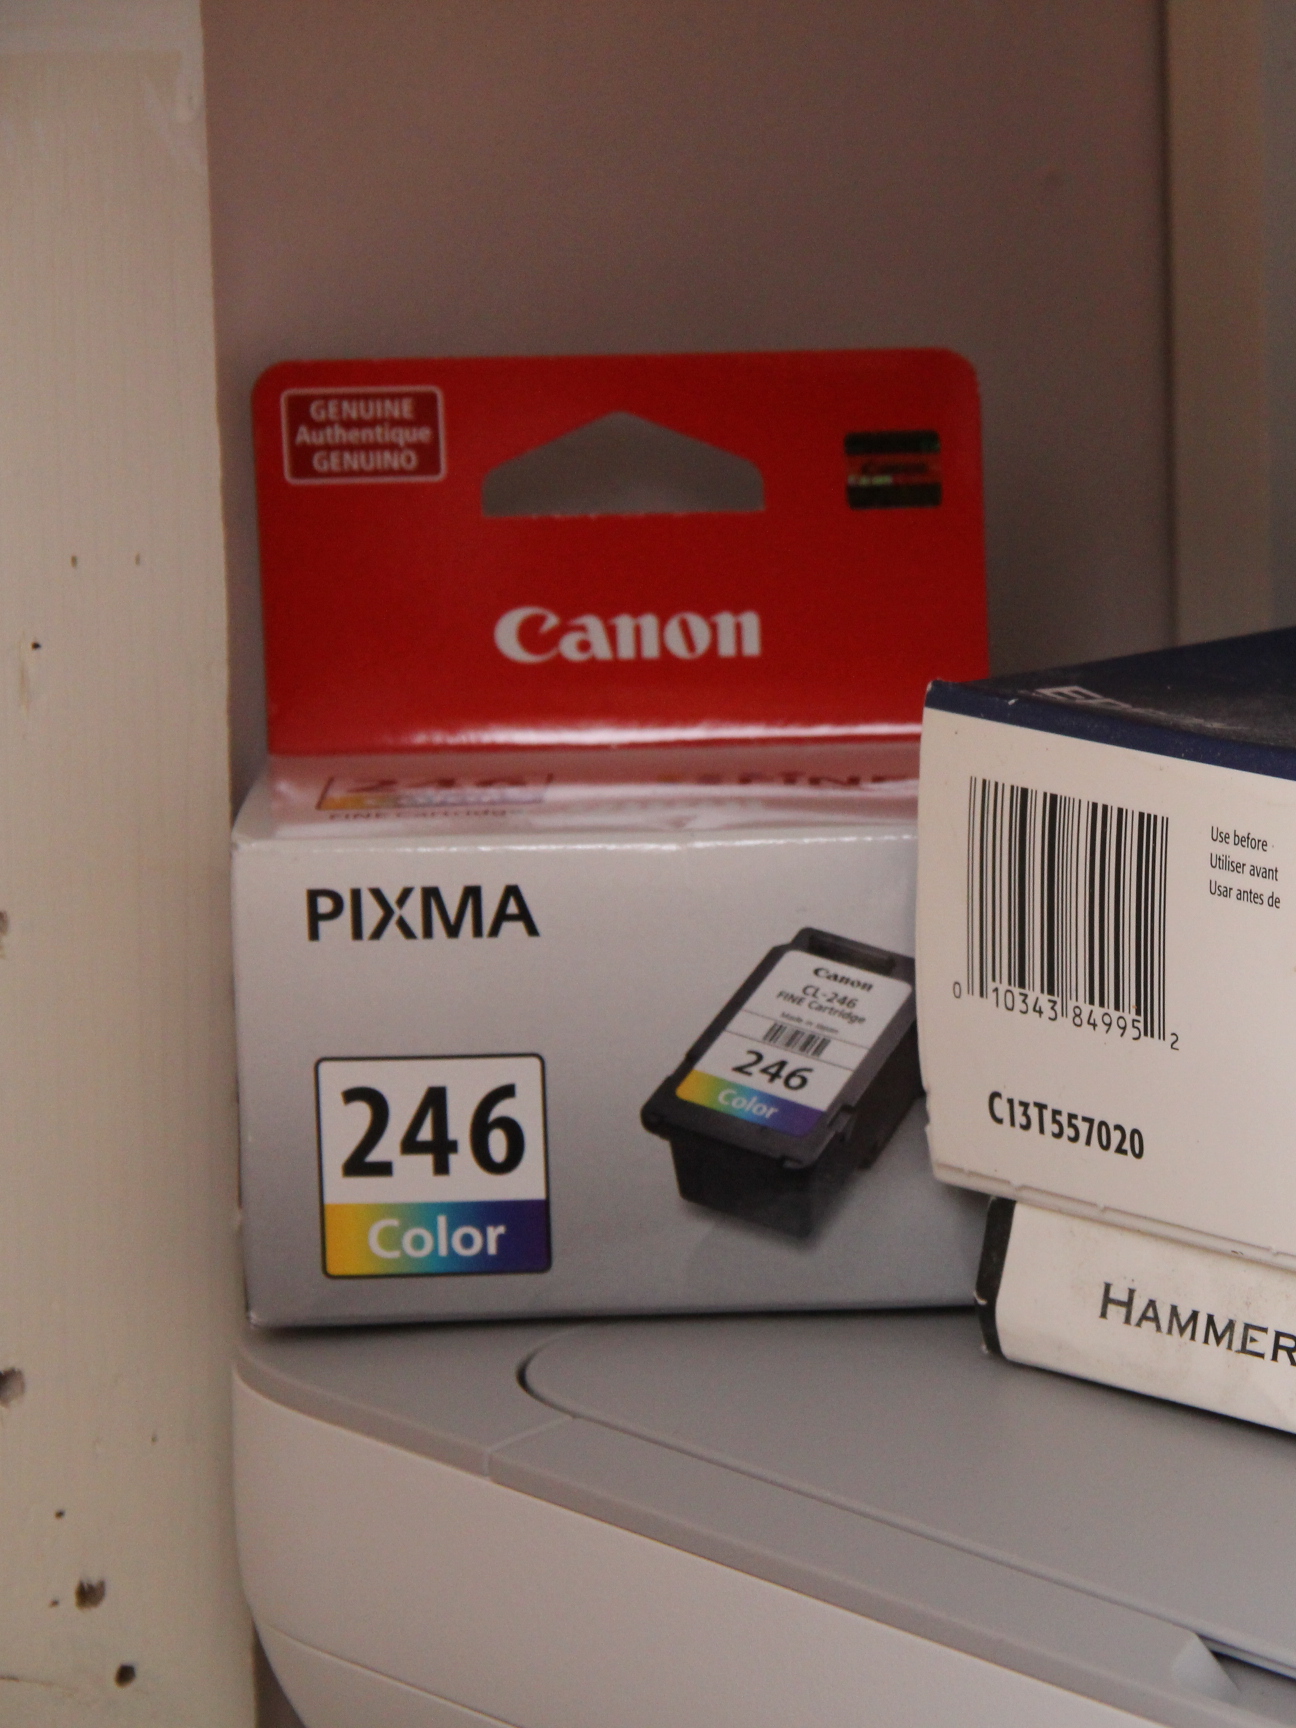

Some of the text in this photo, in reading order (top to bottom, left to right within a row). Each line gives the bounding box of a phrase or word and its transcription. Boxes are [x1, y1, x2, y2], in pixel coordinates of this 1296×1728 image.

[310, 397, 414, 422] GENUINE
[295, 423, 432, 446] Authentique
[312, 449, 419, 473] GENUINO
[494, 606, 761, 664] Canon
[1211, 825, 1268, 852] Use before
[1210, 852, 1279, 881] Utiliser avant
[1209, 879, 1281, 909] Usar antes de
[306, 884, 540, 941] PIXMA
[813, 967, 873, 992] Canon
[776, 990, 866, 1025] FINE Cartridge
[802, 984, 859, 1009] CL-246
[953, 981, 1180, 1051] 0 10343 84995 2
[731, 1050, 814, 1091] 246
[718, 1088, 779, 1118] Color
[340, 1082, 526, 1178] 246
[988, 1091, 1144, 1160] C13T557020
[367, 1215, 506, 1261] Color
